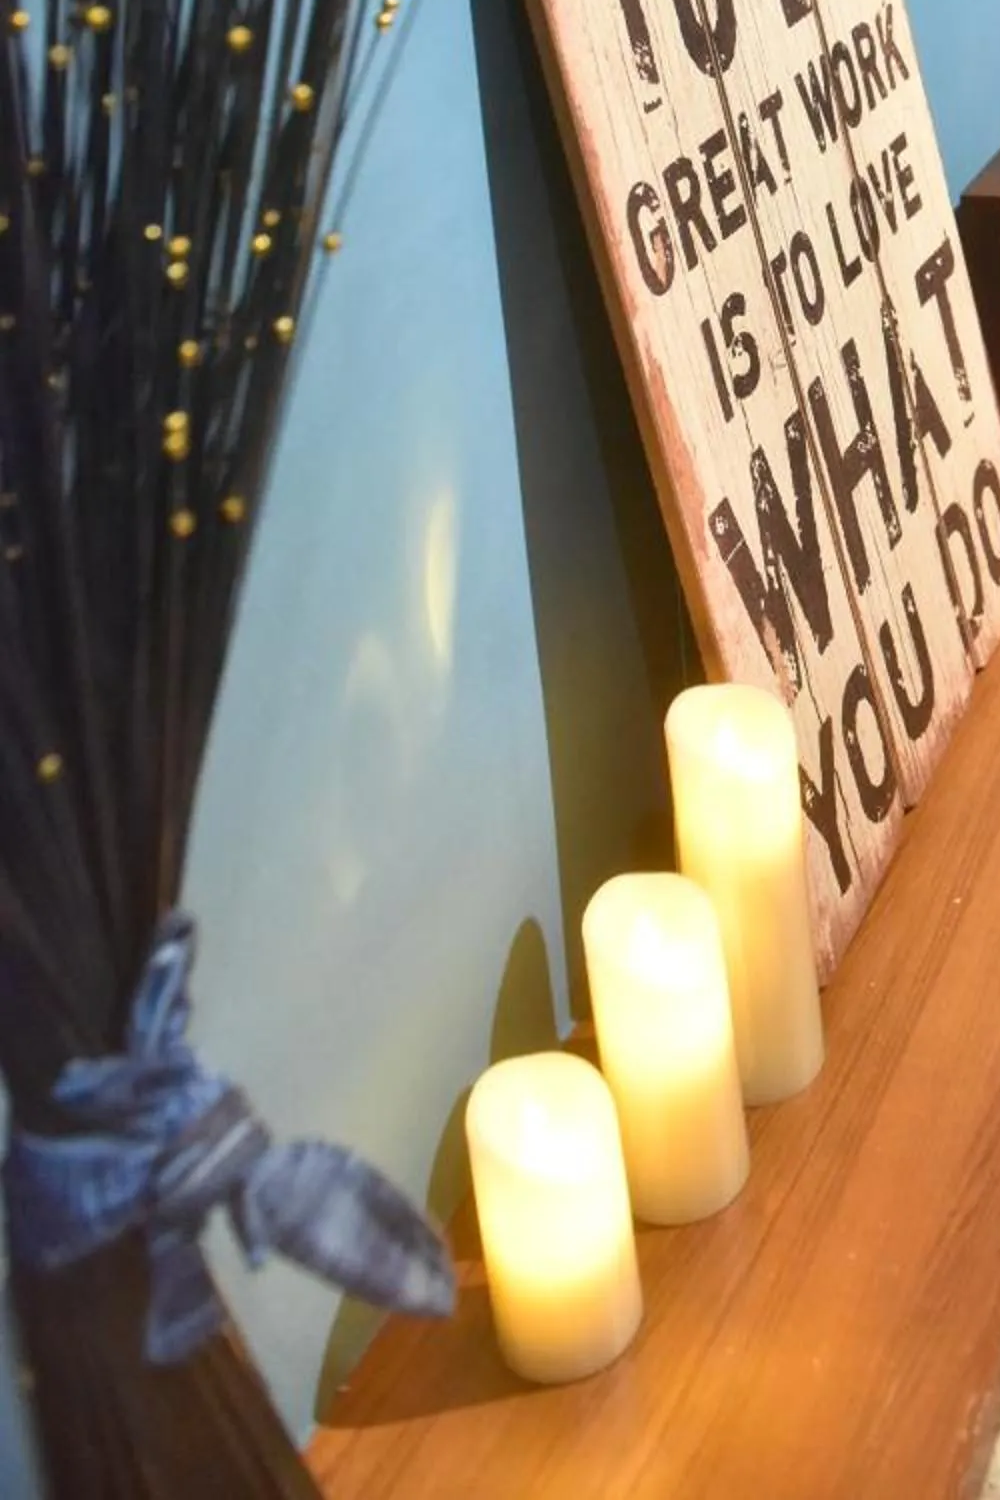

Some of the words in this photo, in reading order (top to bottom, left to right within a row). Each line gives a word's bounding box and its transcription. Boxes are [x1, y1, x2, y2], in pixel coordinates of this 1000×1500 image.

[626, 92, 793, 297] GREAT
[794, 4, 910, 150] WORK
[701, 292, 762, 422] IS
[765, 231, 825, 328] TO
[826, 132, 923, 288] LOVE
[708, 239, 976, 706] WHAT
[799, 582, 935, 895] YOU
